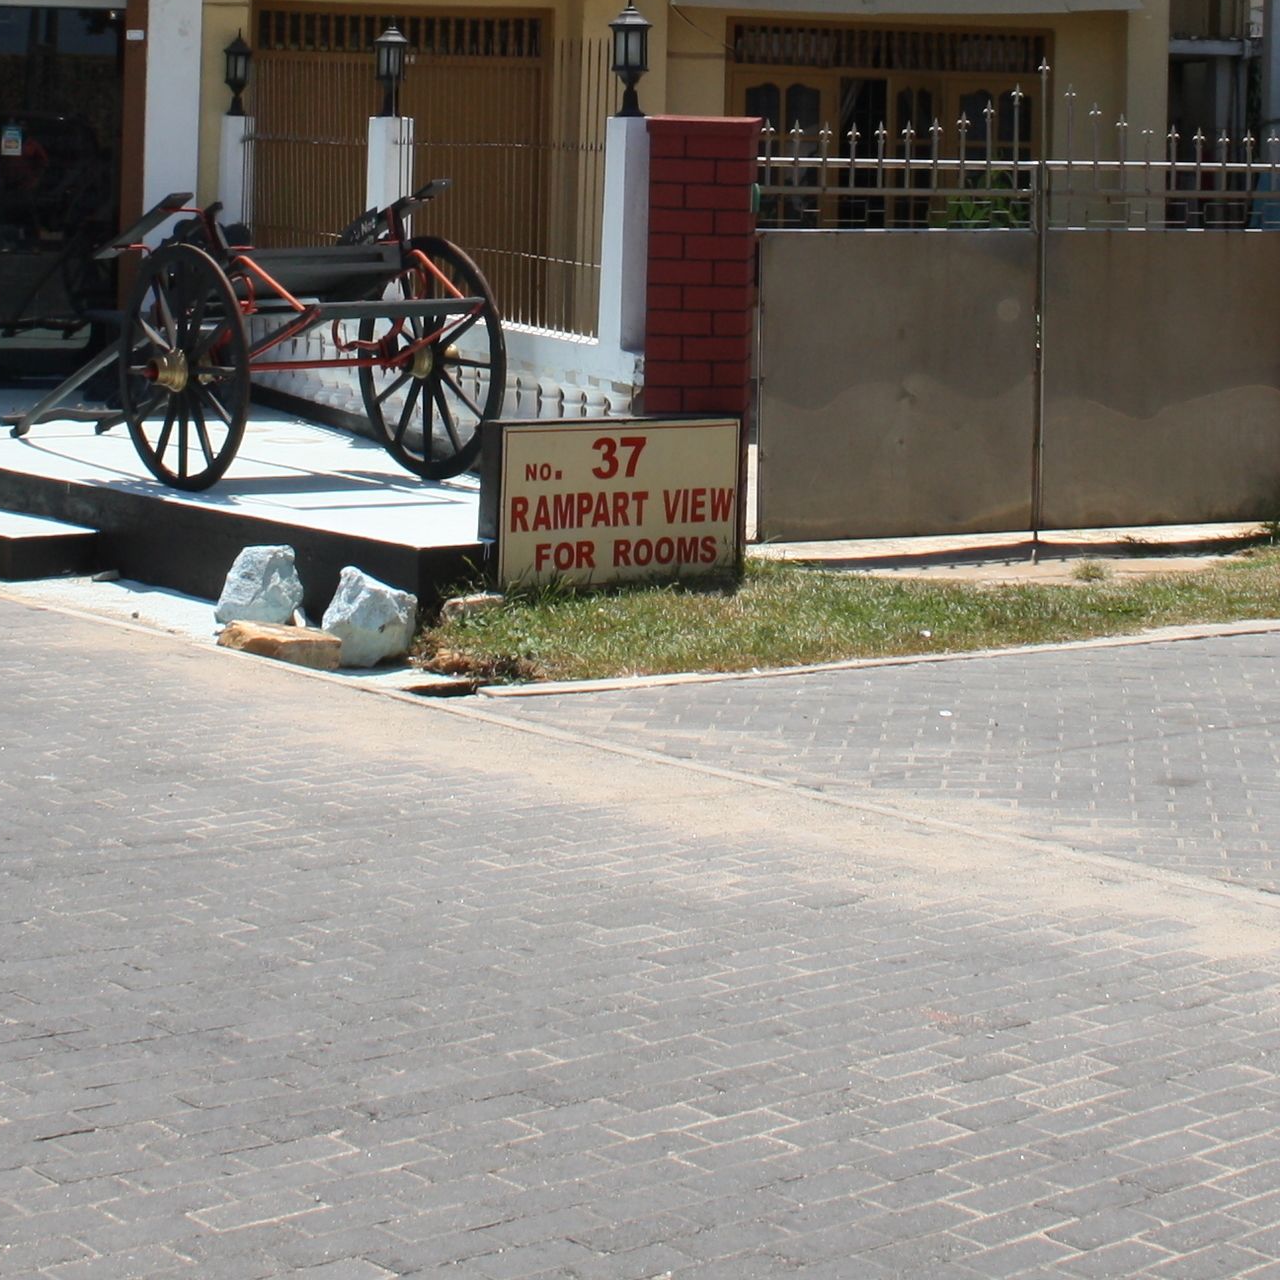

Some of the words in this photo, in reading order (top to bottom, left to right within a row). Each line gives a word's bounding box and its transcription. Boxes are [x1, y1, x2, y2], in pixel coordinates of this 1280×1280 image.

[525, 463, 562, 482] NO.
[591, 436, 647, 480] 37
[510, 491, 649, 533] RAMPART
[663, 487, 734, 525] VIEW
[535, 541, 595, 572] FOR
[613, 535, 718, 567] ROOMS
